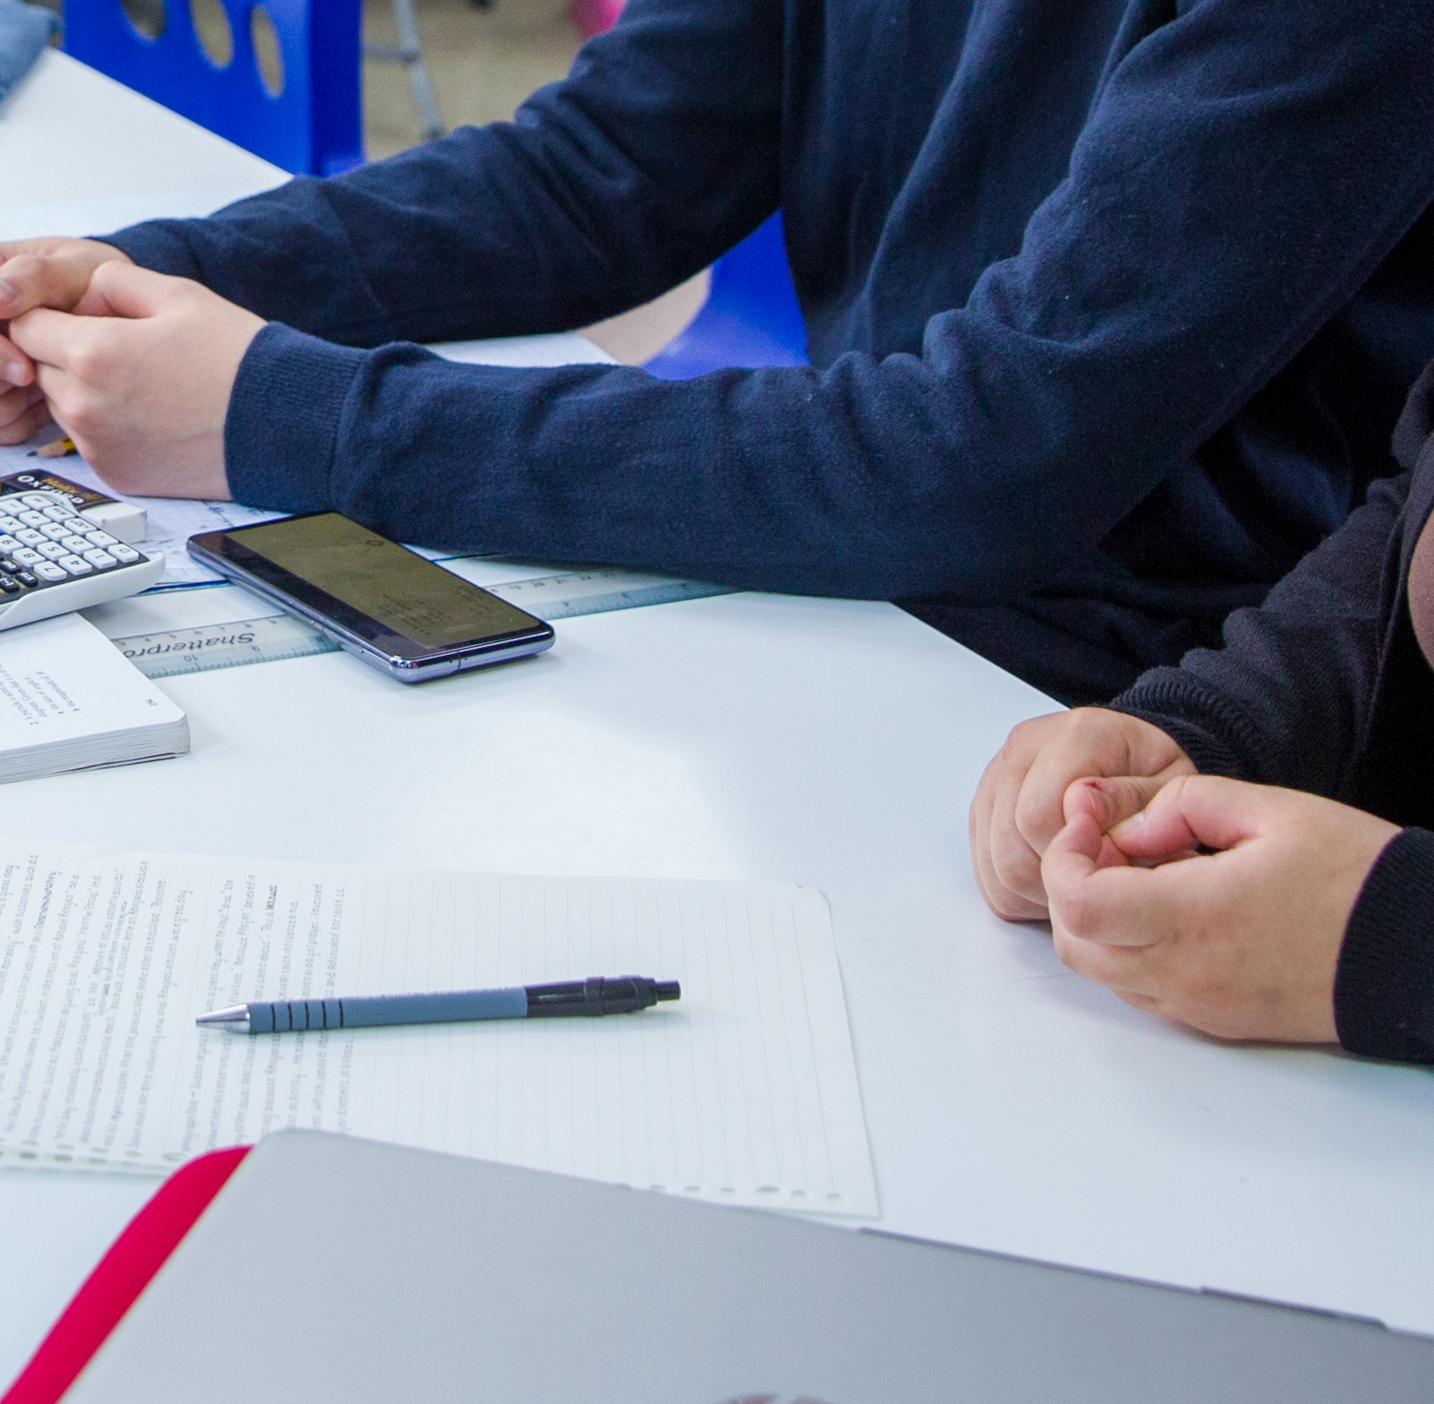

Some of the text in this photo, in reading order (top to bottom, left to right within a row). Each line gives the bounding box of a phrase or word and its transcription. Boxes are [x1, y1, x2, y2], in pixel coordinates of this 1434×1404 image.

[123, 632, 255, 658] Shatterpro
[184, 654, 199, 662] 10
[24, 866, 36, 881] such
[69, 874, 80, 888] and
[327, 932, 339, 970] advocated
[326, 971, 335, 986] and
